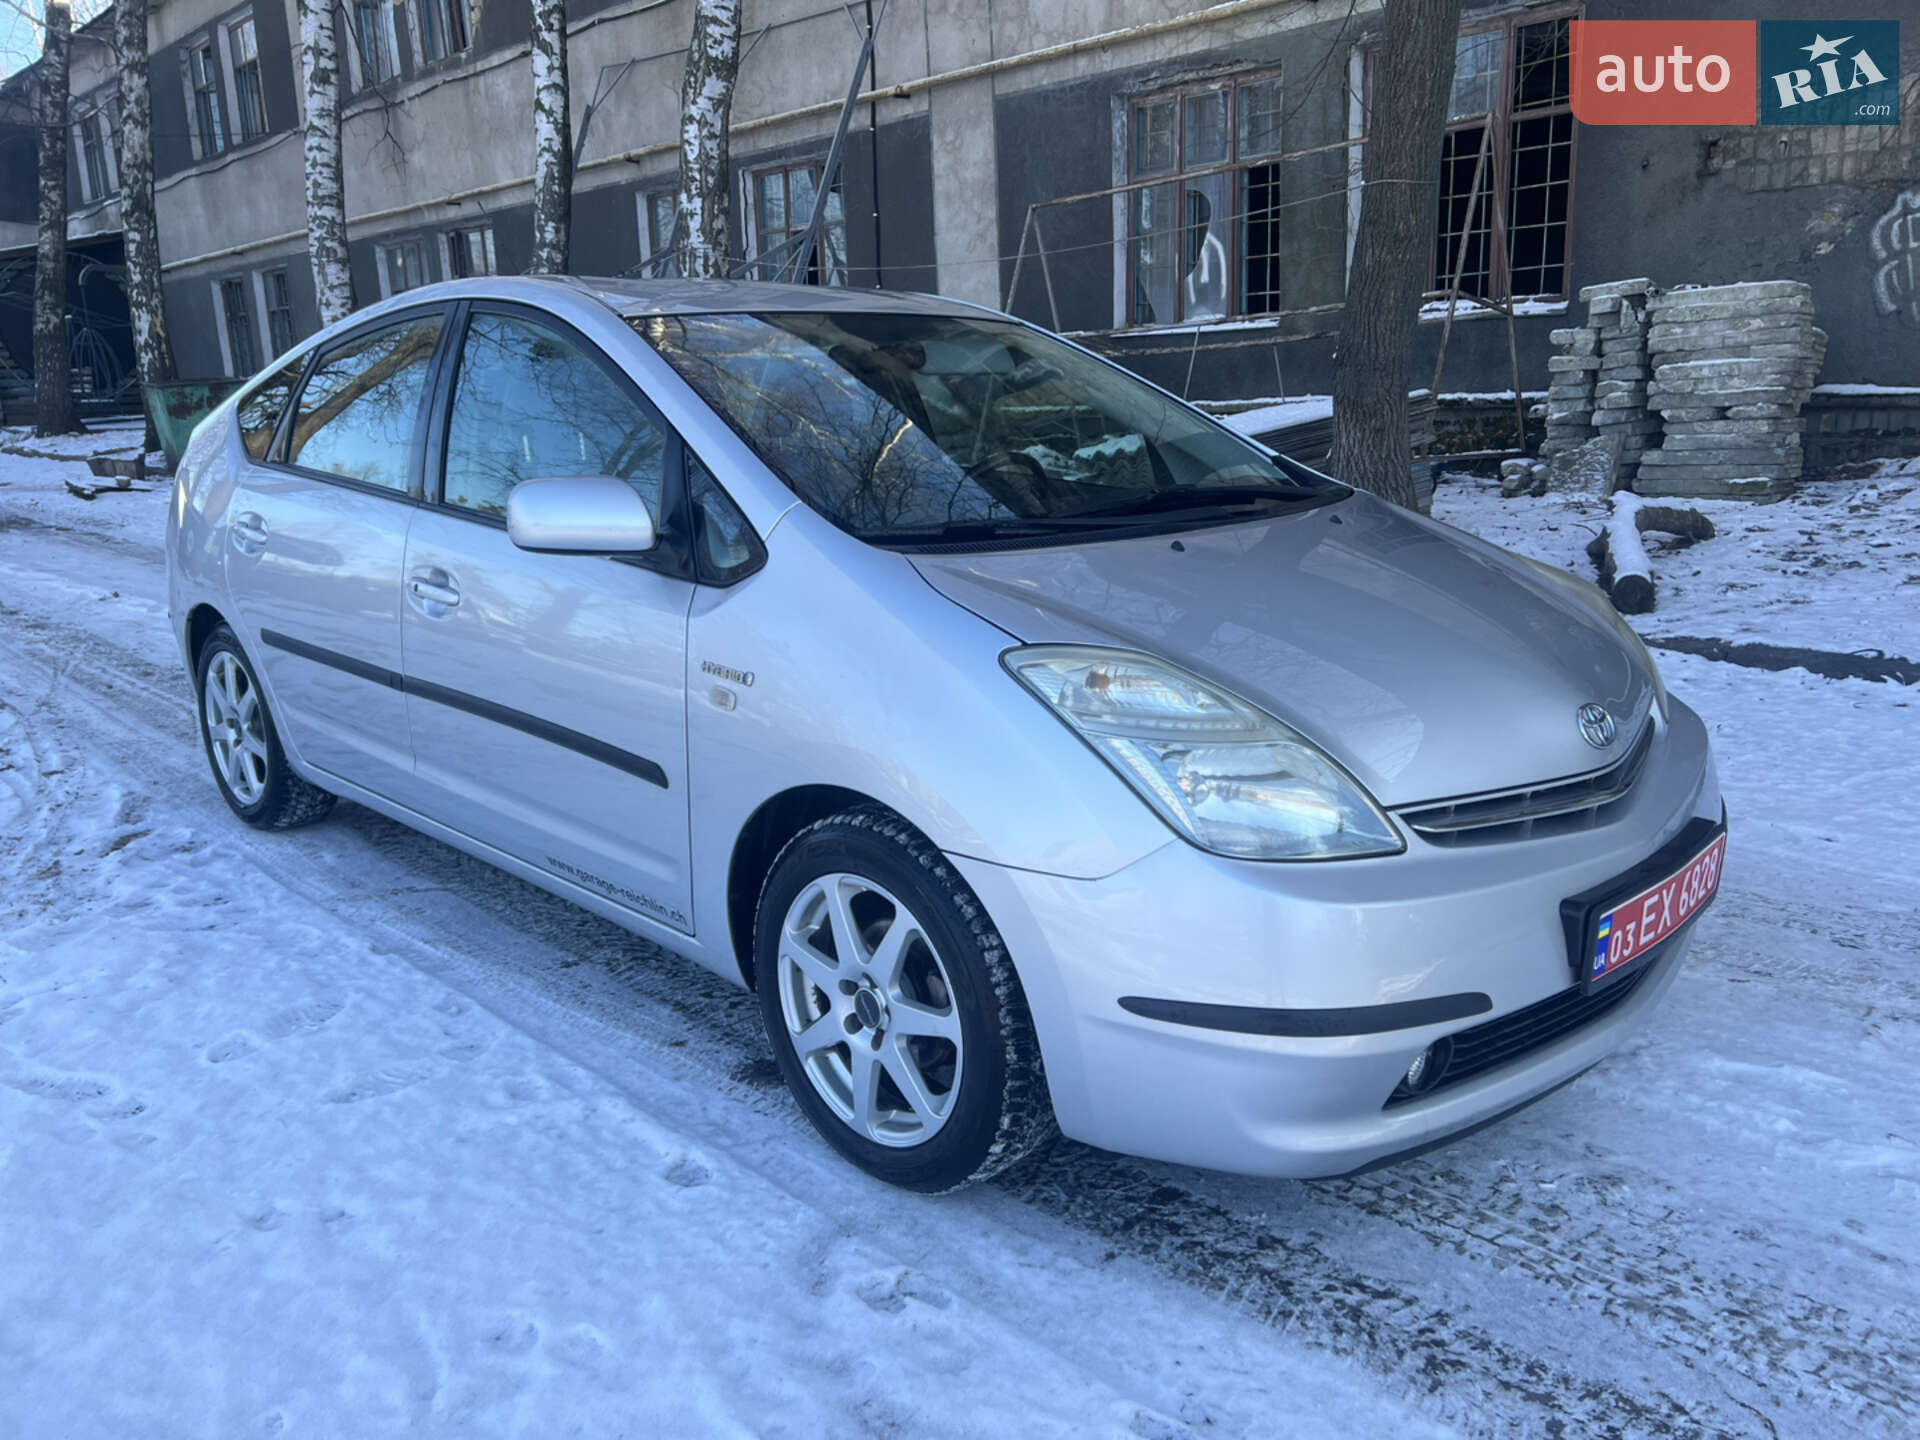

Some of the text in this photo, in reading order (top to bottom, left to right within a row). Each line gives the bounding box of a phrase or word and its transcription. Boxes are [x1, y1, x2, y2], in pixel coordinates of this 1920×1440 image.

[701, 660, 755, 687] HYBRID
[1609, 847, 1719, 963] 03 EX 6828
[1593, 951, 1606, 970] UA
